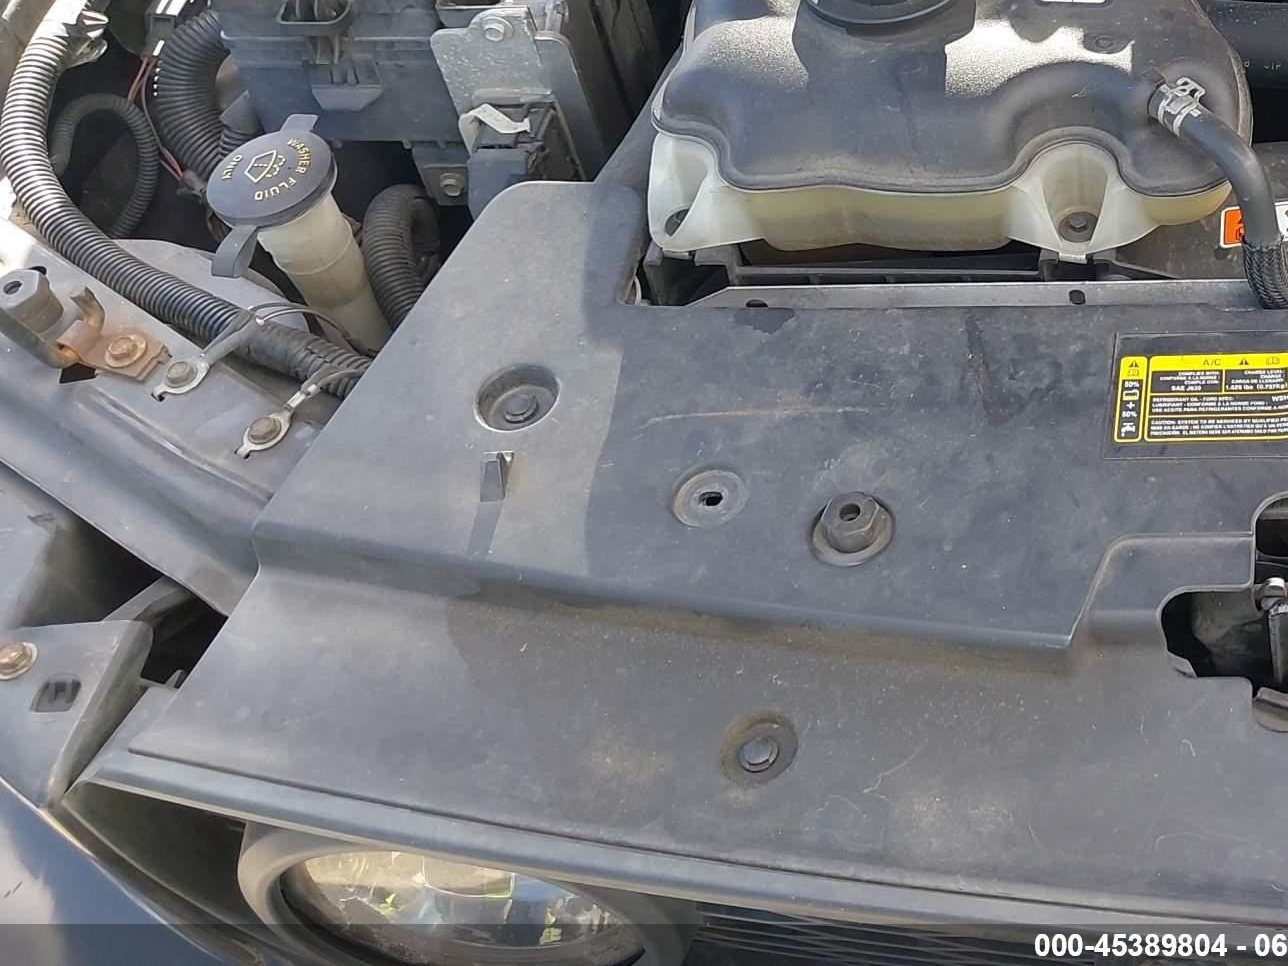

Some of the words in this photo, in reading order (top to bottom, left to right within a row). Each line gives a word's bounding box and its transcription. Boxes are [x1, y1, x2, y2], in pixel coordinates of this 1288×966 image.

[222, 154, 243, 180] ONLY
[286, 138, 312, 174] WASHER
[254, 177, 296, 200] FLUID
[1202, 358, 1222, 366] A/C
